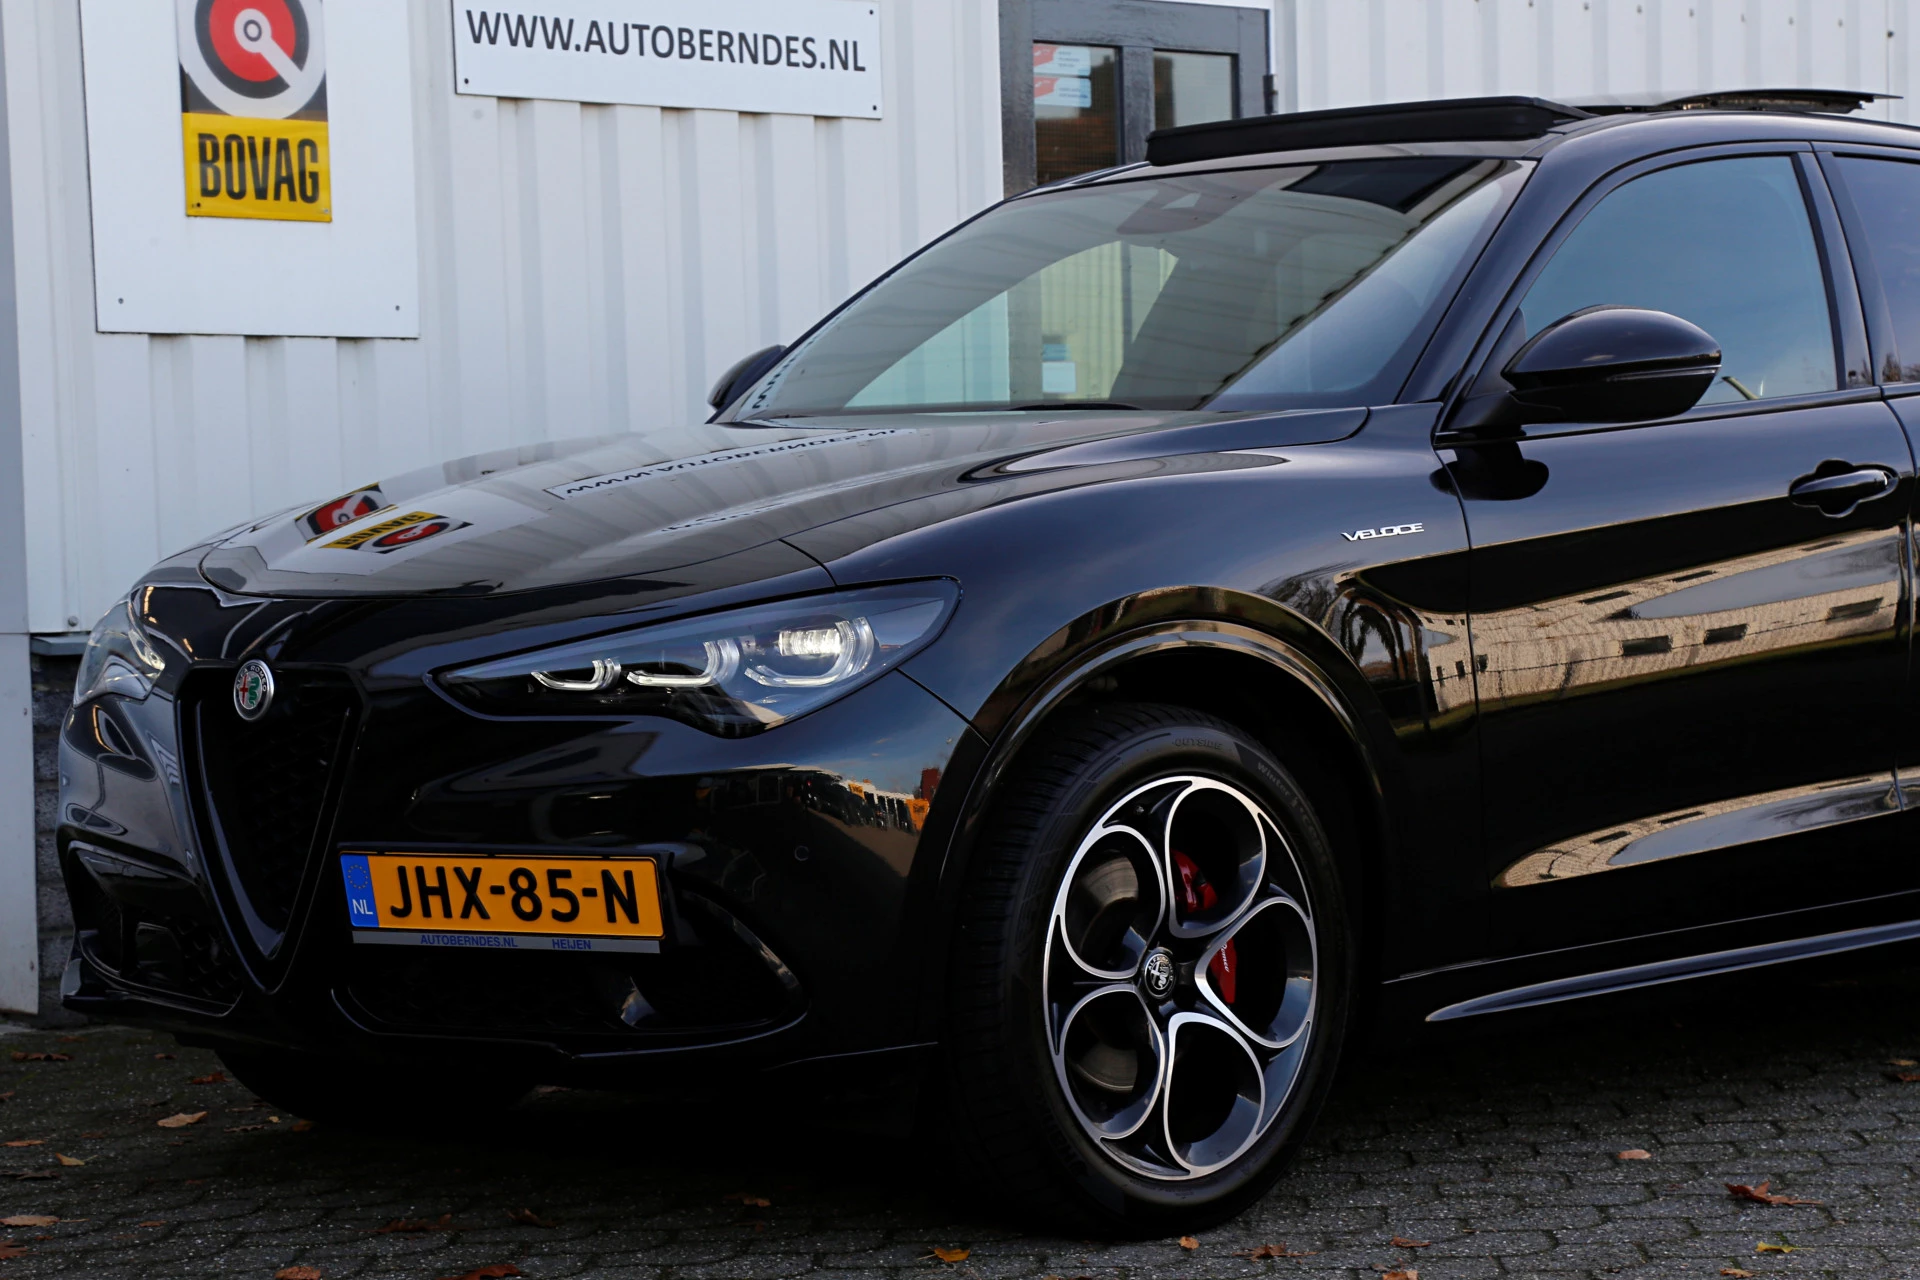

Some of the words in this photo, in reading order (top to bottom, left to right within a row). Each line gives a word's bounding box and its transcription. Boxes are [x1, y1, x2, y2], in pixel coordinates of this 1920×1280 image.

[466, 9, 866, 72] WWW.AUTOBERNDES.NL
[198, 132, 319, 204] BOVAG
[1340, 522, 1425, 541] VELOCE
[250, 665, 267, 692] ROMEO
[1257, 761, 1292, 796] Winter
[352, 898, 374, 916] NL
[389, 864, 640, 925] JHX-85-N
[420, 933, 519, 949] AUTOBERNDES.NL
[551, 938, 592, 951] HEIJEN
